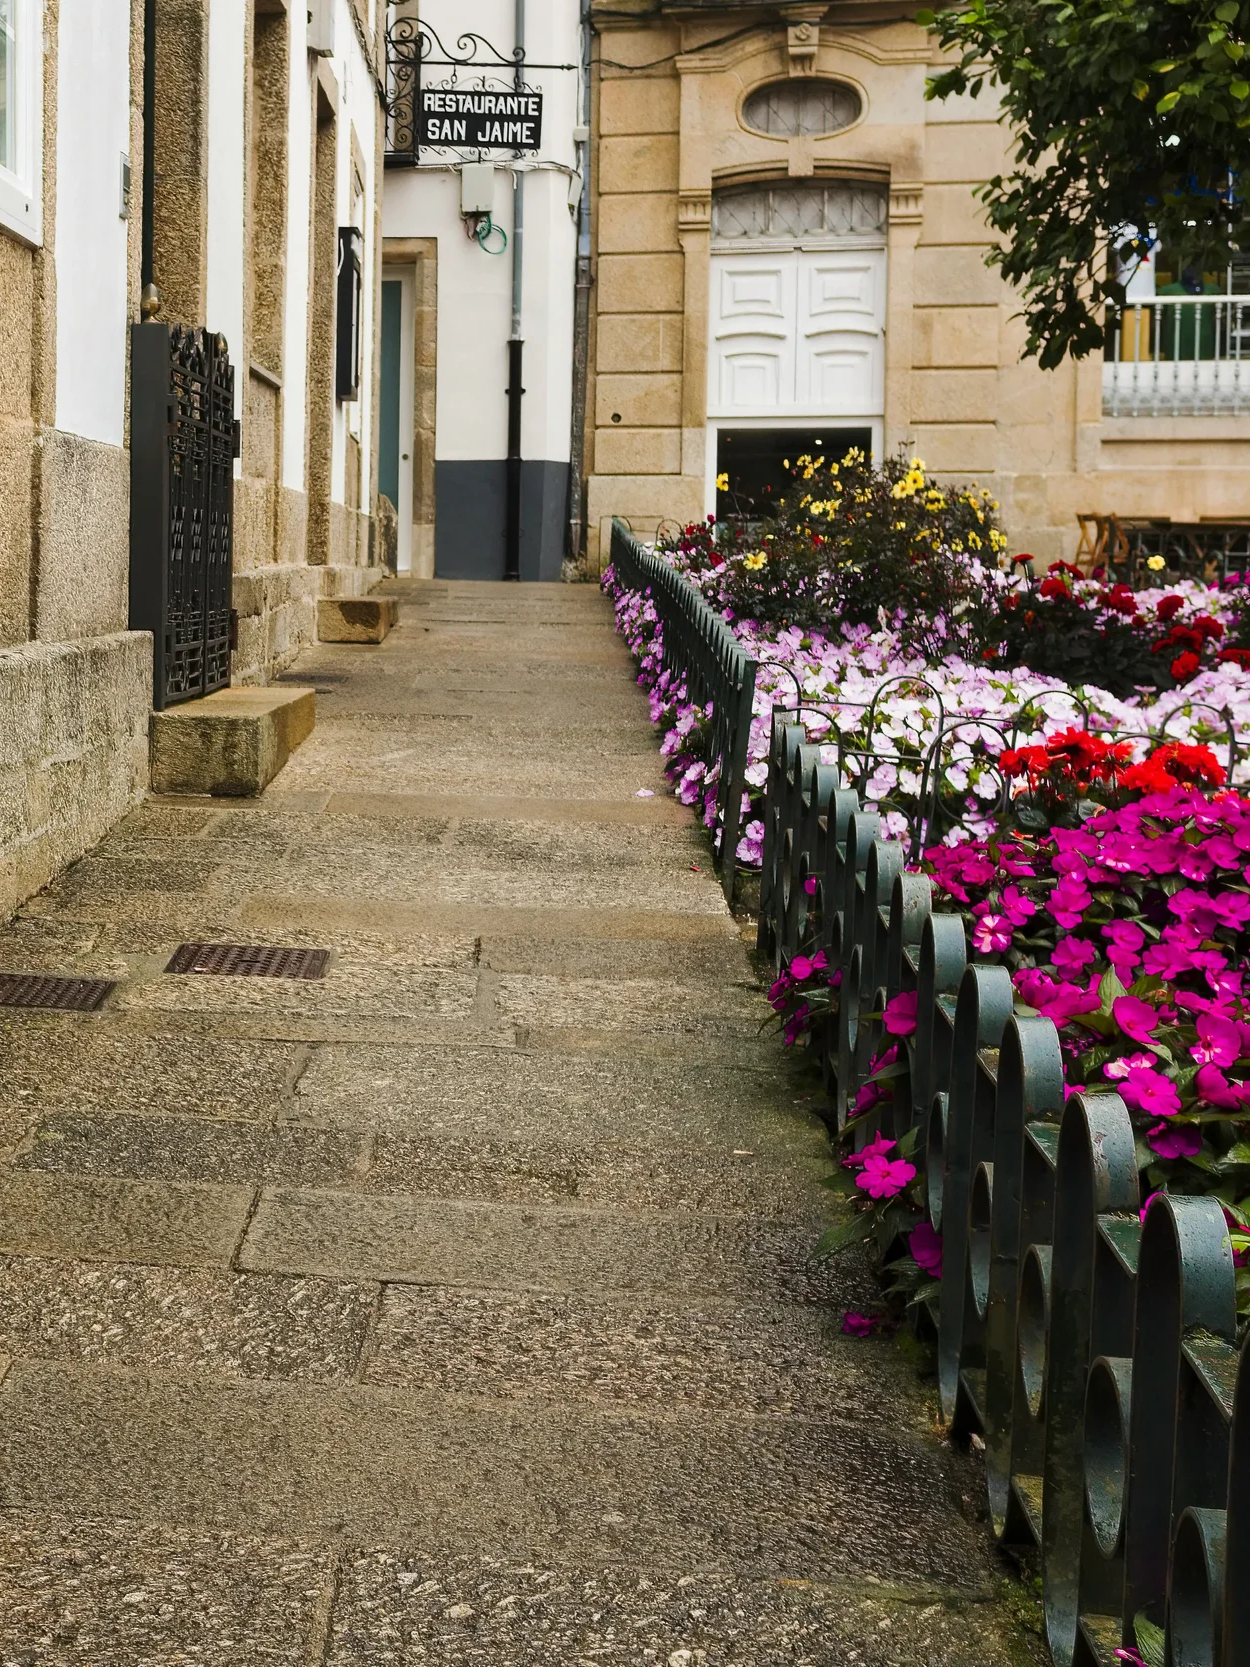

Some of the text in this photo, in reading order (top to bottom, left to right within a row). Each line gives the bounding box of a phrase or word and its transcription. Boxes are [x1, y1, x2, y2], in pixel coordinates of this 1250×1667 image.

[424, 93, 539, 116] RESTAURANTE
[427, 119, 535, 143] SAN JAIME
